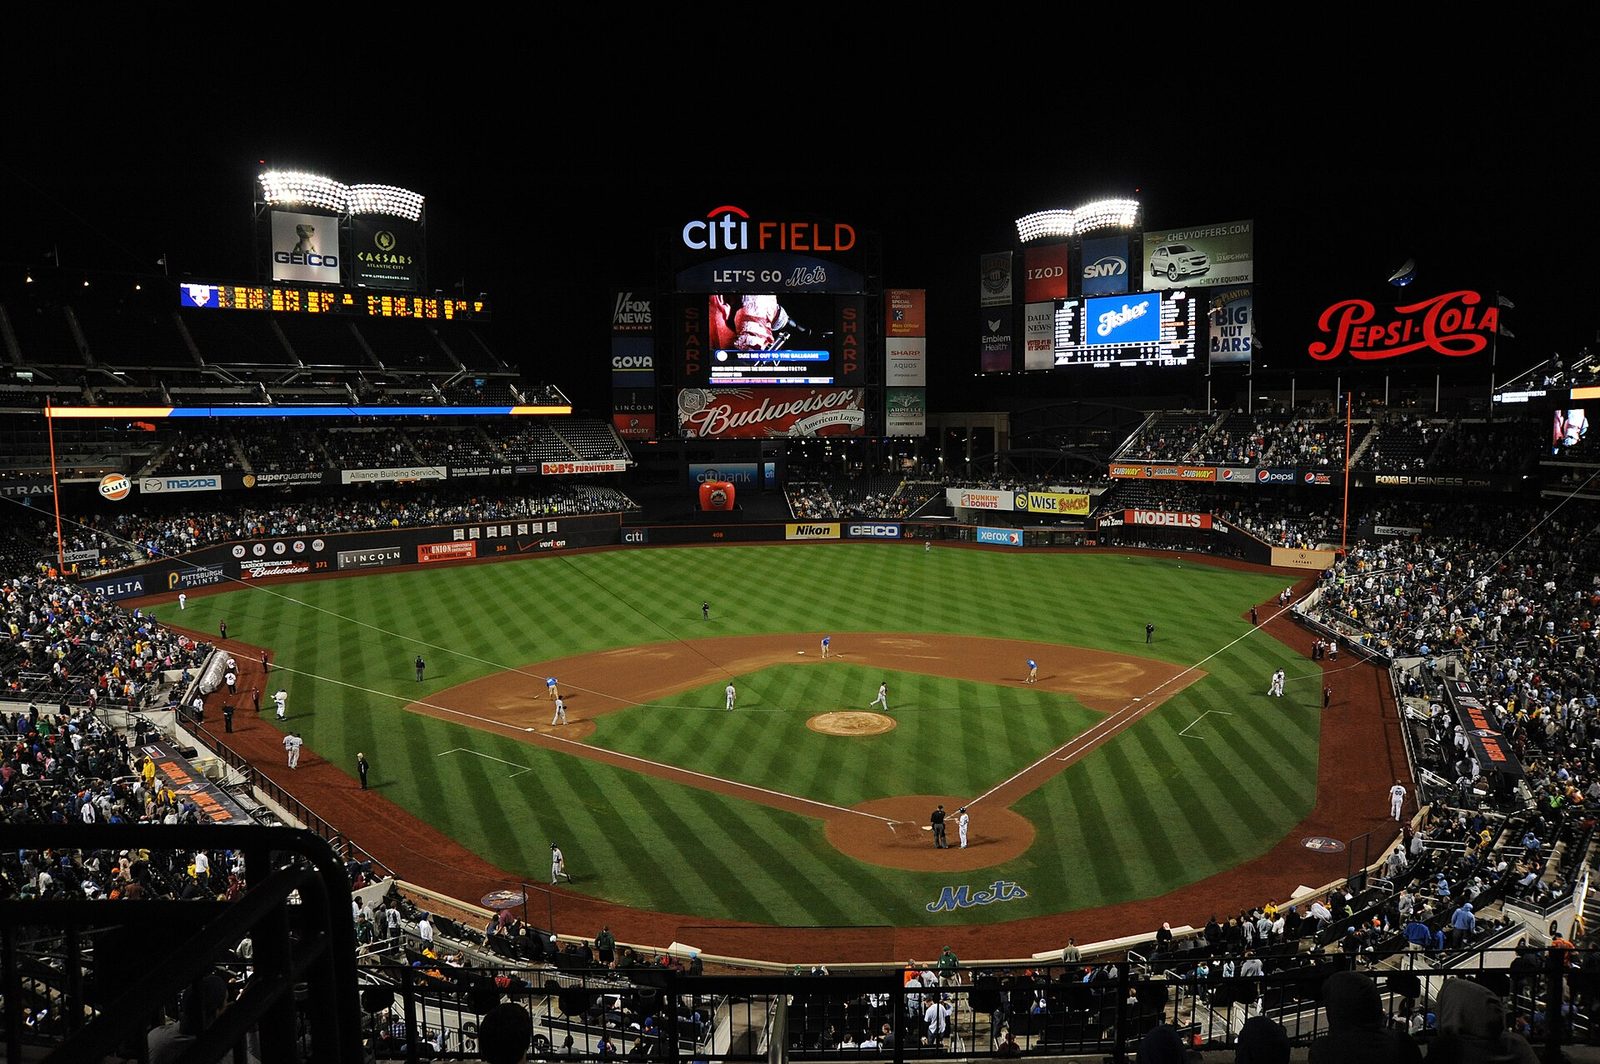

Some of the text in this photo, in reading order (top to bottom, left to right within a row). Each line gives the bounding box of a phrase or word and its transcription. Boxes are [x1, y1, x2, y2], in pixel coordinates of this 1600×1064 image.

[682, 214, 856, 251] citi FIELD
[1167, 224, 1250, 242] CHEVYOFFERS.COM
[274, 251, 338, 267] GEICO
[357, 252, 413, 264] CAESARS
[714, 266, 826, 286] LET'S GO Mets
[1028, 266, 1064, 280] IZOD
[1084, 262, 1119, 278] SNY
[1221, 275, 1249, 283] EQUINOX
[626, 301, 651, 312] FOX
[618, 313, 652, 323] NEWS
[1028, 314, 1051, 322] DAILY
[1097, 300, 1149, 336] Fisher
[1216, 306, 1247, 326] BIG
[1221, 326, 1243, 337] NUT
[685, 308, 700, 375] SHARP
[843, 308, 857, 375] SHARP
[982, 335, 1011, 344] Emblem
[1211, 336, 1251, 352] BARS
[612, 356, 652, 368] GOYA
[690, 389, 853, 437] Budweiser
[803, 414, 862, 431] American Lager
[543, 463, 574, 474] BOB'S
[1112, 467, 1141, 476] SUBWAY
[1181, 469, 1214, 478] SUBWAY
[257, 472, 322, 482] superguarantee
[696, 470, 751, 483] citibank
[1271, 473, 1294, 481] pepsi
[101, 480, 128, 496] Gulf
[167, 479, 216, 488] mazda
[1030, 496, 1088, 512] WISE SNACKS
[1134, 511, 1201, 528] MODELL'S
[796, 525, 830, 536] Nikon
[849, 525, 898, 536] GEICO
[981, 531, 1008, 541] xerox
[625, 532, 643, 542] citi
[432, 545, 452, 553] UNION
[540, 539, 566, 548] verizon
[346, 552, 400, 563] LINCOLN
[181, 569, 223, 581] PITTSBURGH
[249, 566, 309, 578] Budweiser
[186, 576, 219, 586] PAINTS
[95, 581, 142, 596] DELTA
[926, 880, 1028, 912] Mets
